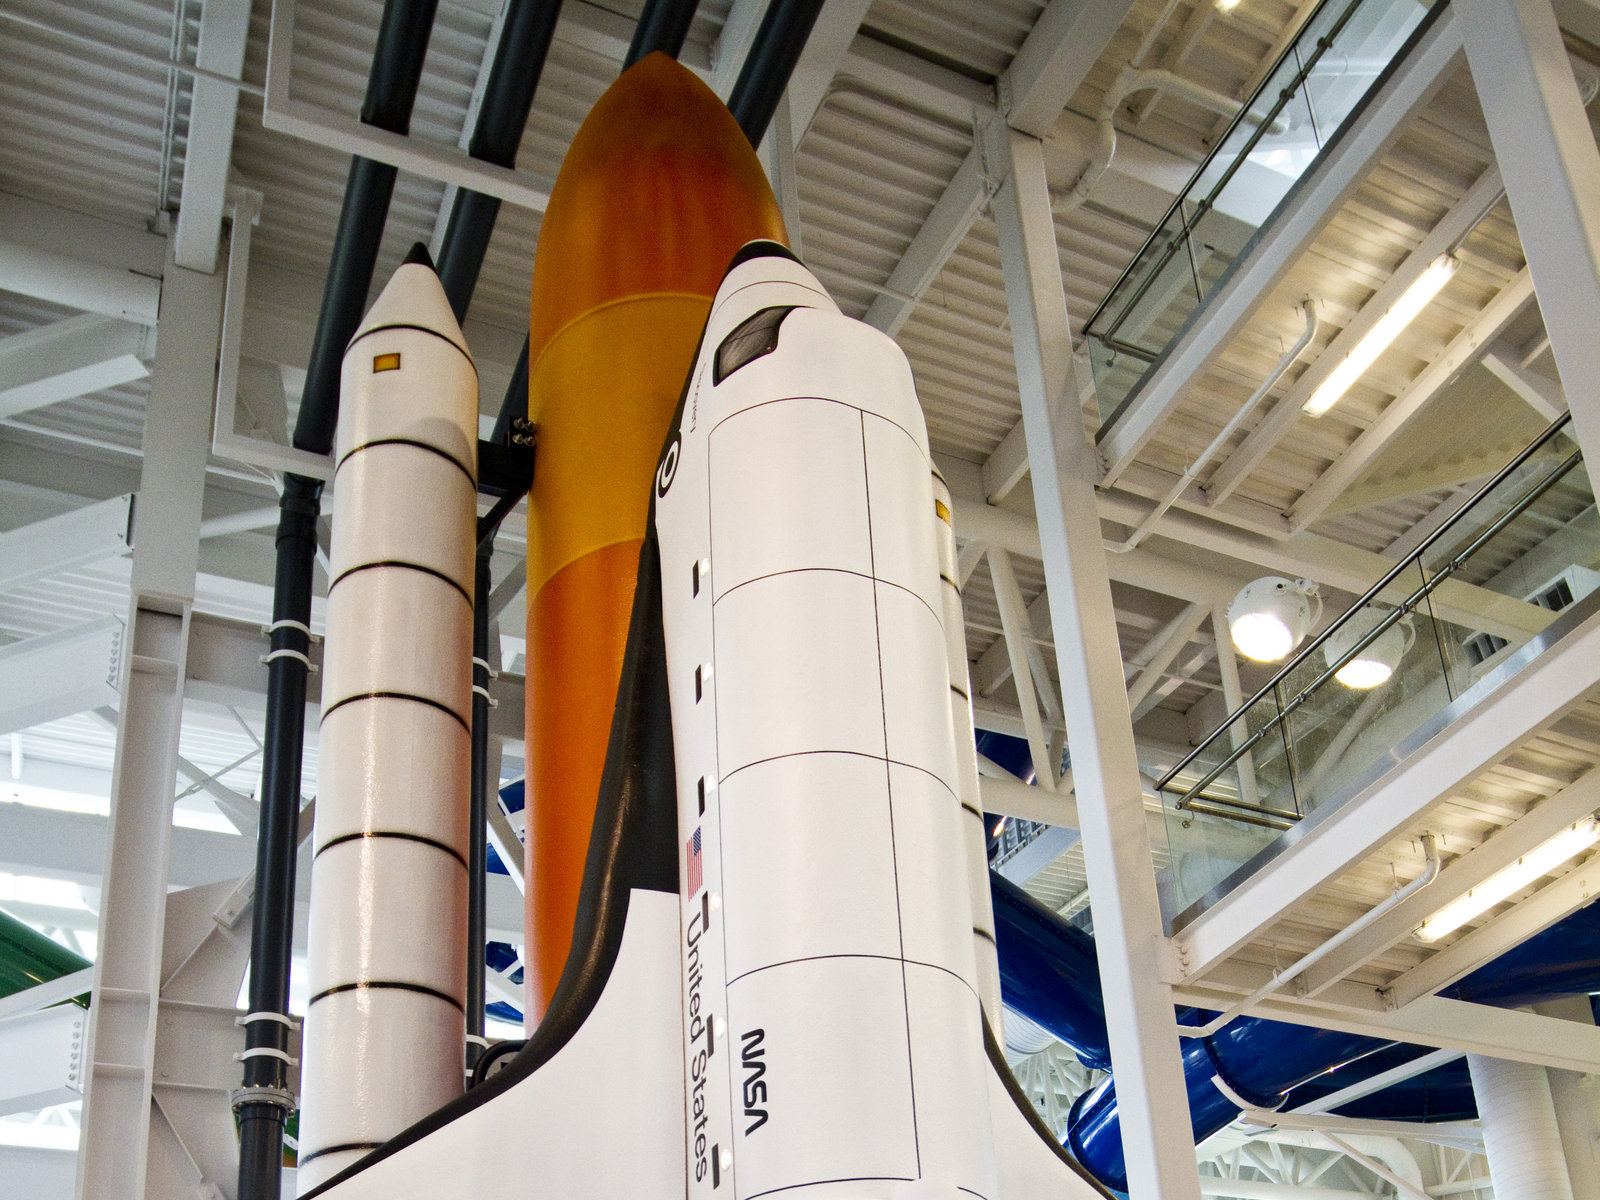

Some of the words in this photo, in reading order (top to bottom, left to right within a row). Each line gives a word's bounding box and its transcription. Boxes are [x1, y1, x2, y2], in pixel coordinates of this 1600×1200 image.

[687, 911, 706, 1044] United
[691, 1049, 708, 1183] States
[741, 1028, 769, 1137] NASA
